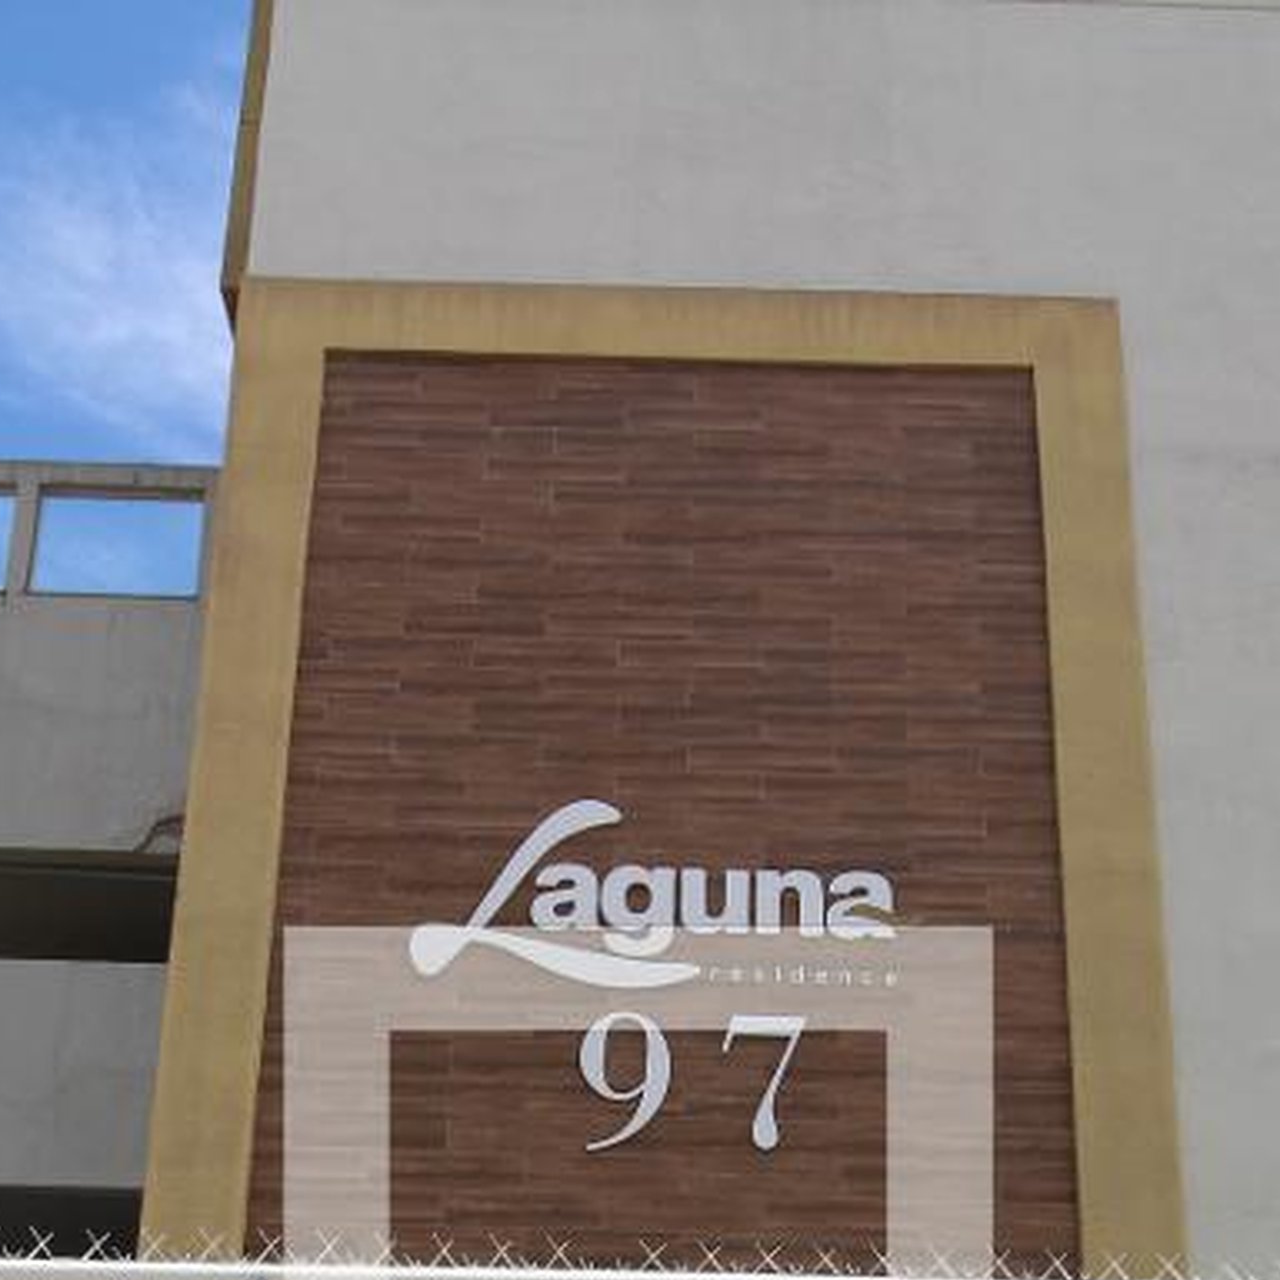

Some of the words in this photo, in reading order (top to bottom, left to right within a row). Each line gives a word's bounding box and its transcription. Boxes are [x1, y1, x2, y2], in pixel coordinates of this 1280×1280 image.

[409, 799, 896, 988] Laguna
[709, 965, 899, 986] residence
[579, 1012, 807, 1151] 97
